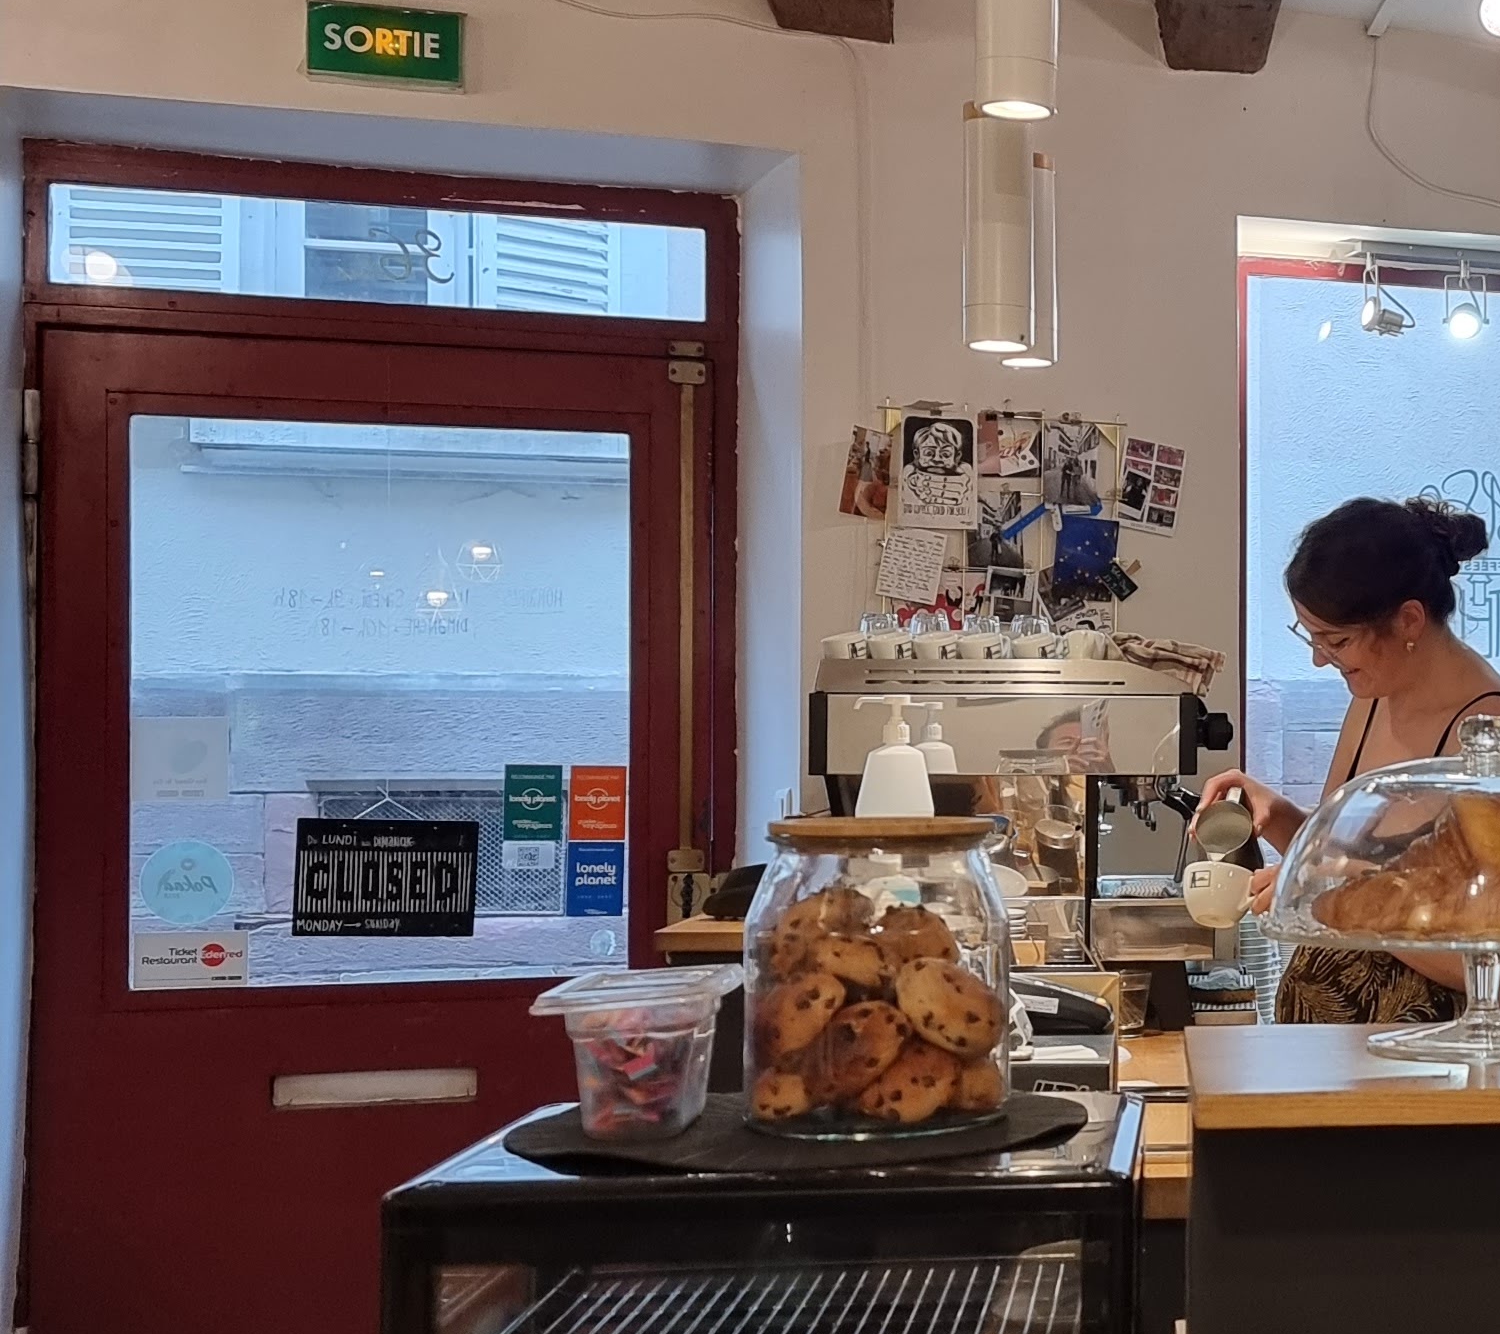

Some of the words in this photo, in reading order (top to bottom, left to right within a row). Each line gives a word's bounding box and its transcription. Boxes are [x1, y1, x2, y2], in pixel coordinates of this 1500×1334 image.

[323, 22, 440, 59] SORTIE
[509, 794, 531, 805] lonely
[532, 794, 557, 805] planet
[574, 794, 596, 805] lonely
[597, 794, 620, 805] planet
[576, 861, 616, 876] lonely
[305, 856, 459, 905] CLOSED
[575, 874, 617, 887] planet
[296, 918, 343, 932] MONDAY
[169, 948, 198, 957] Ticket
[201, 950, 243, 959] Edenred
[141, 956, 198, 966] Restaurant
